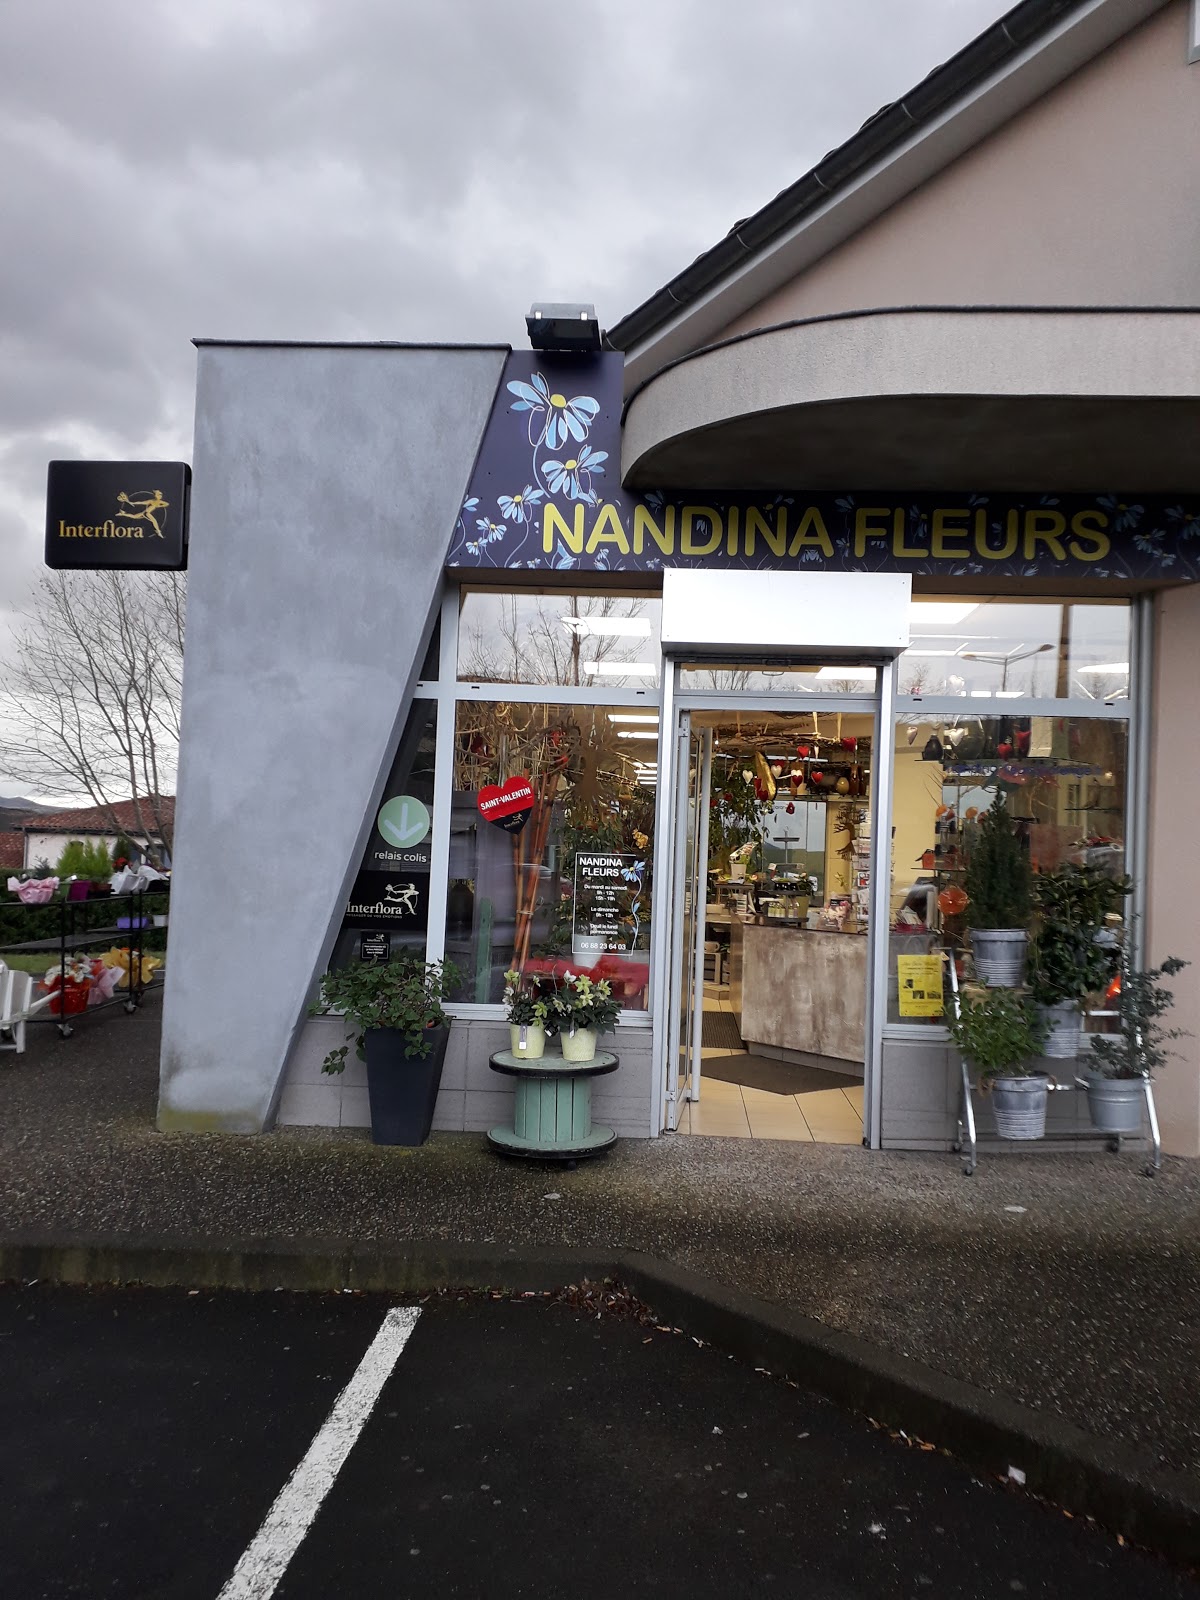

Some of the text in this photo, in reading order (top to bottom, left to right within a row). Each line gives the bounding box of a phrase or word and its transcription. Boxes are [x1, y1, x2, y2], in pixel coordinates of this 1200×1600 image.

[59, 520, 144, 538] Interflora
[542, 502, 1111, 562] NANDINA FLEURS
[480, 786, 531, 811] SAINT-VALENTIN
[374, 851, 427, 863] relais colis
[579, 857, 623, 867] NANDINA
[582, 867, 620, 877] FLEURS
[346, 901, 402, 915] Interflora
